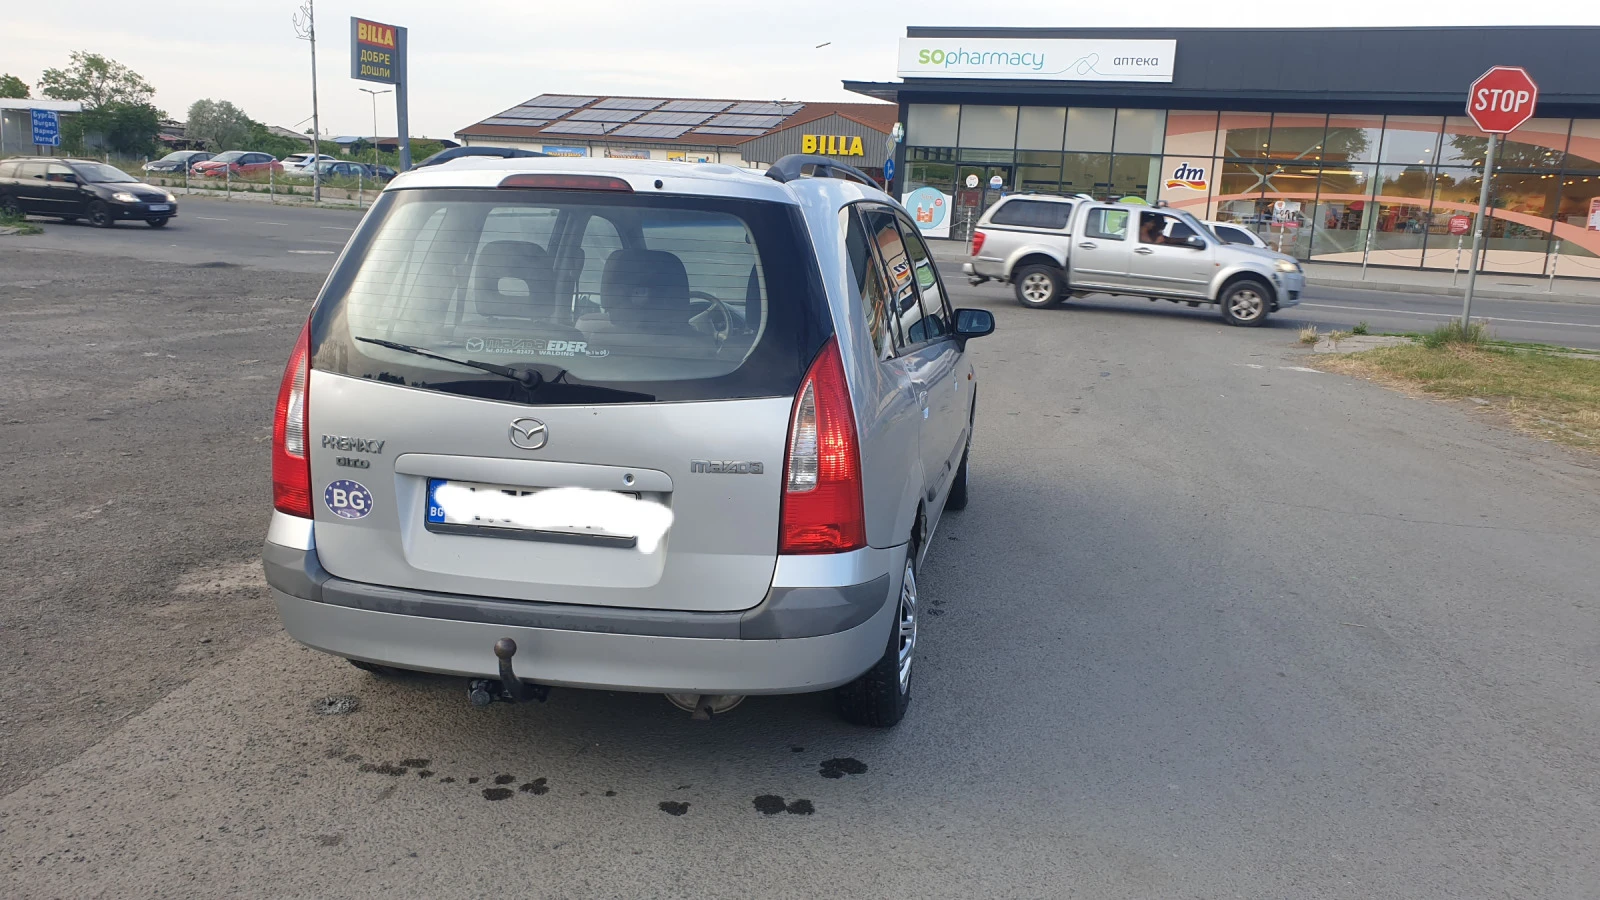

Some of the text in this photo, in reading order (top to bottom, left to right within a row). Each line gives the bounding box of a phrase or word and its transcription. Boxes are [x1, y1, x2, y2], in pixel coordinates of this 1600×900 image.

[358, 22, 394, 47] BILLA
[360, 49, 391, 65] ДОБРЕ
[918, 47, 1044, 71] sopharmacy
[1113, 57, 1159, 66] аптека
[360, 64, 391, 78] ДОШЛИ
[1475, 88, 1530, 113] STOP
[33, 119, 55, 127] Burgas
[802, 134, 864, 157] BILLA
[1174, 163, 1204, 180] dm
[547, 340, 588, 353] EDER
[321, 434, 386, 455] PREMACY
[333, 488, 365, 510] BG
[430, 506, 444, 517] BG
